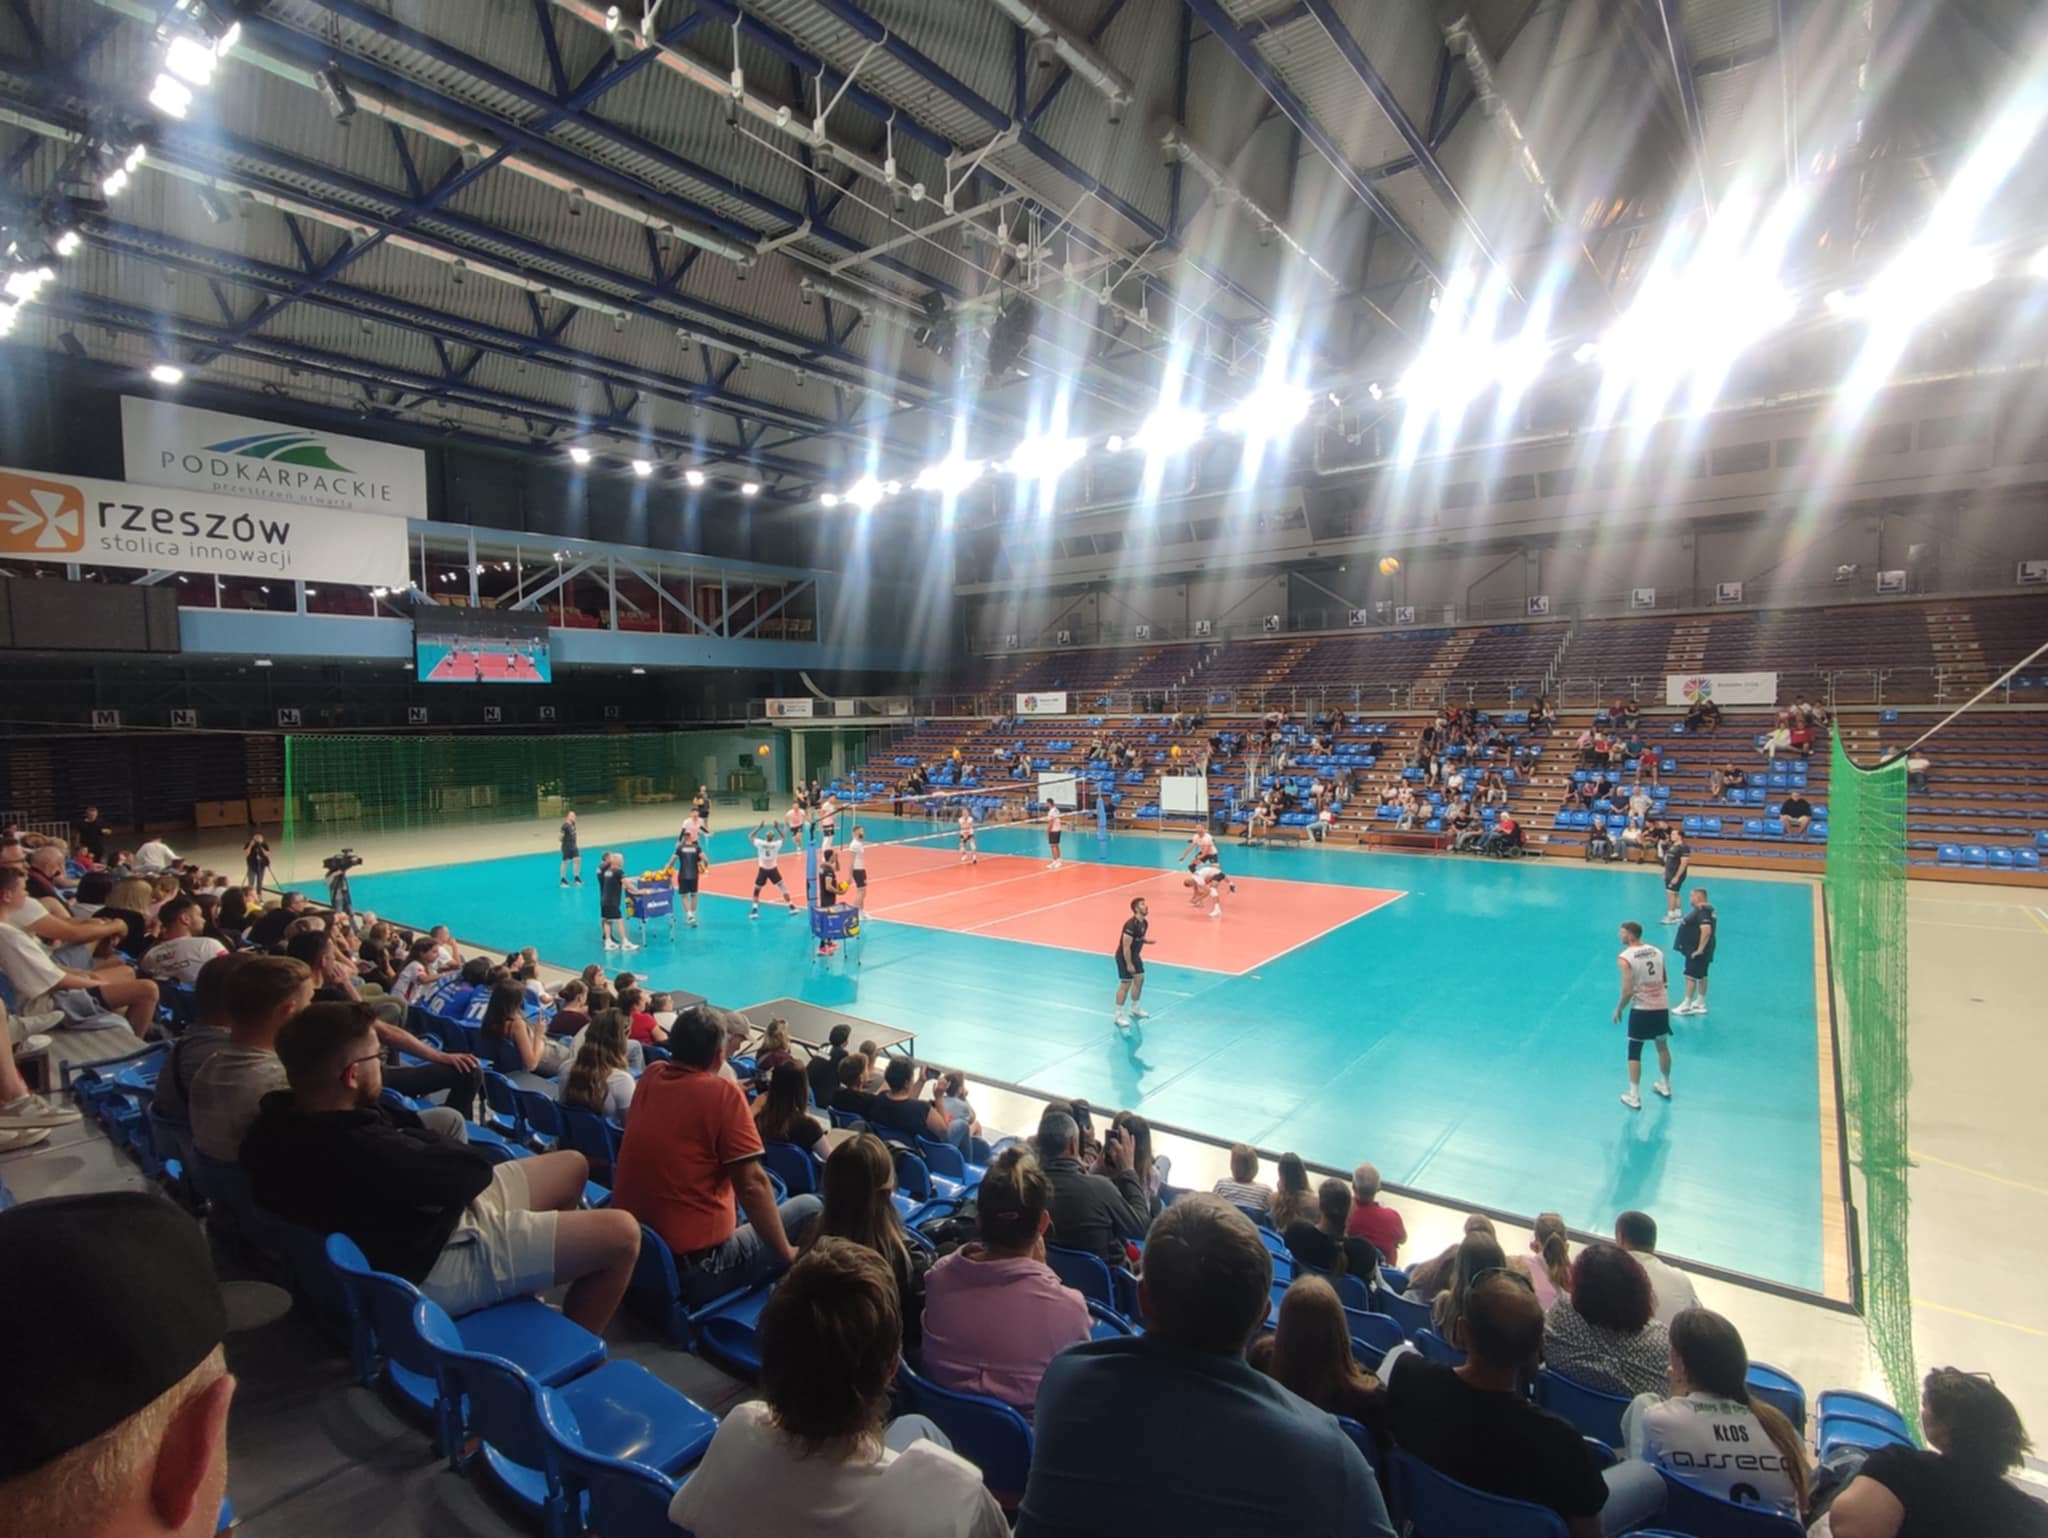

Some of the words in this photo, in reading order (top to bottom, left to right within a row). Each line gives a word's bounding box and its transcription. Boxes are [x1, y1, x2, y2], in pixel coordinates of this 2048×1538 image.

[161, 451, 392, 501] PODKARPACKIE
[98, 501, 290, 545] rzeszów
[100, 534, 180, 556] stolica
[189, 542, 292, 570] innowacji
[1646, 961, 1656, 976] 2
[1713, 1423, 1750, 1443] KŁOS
